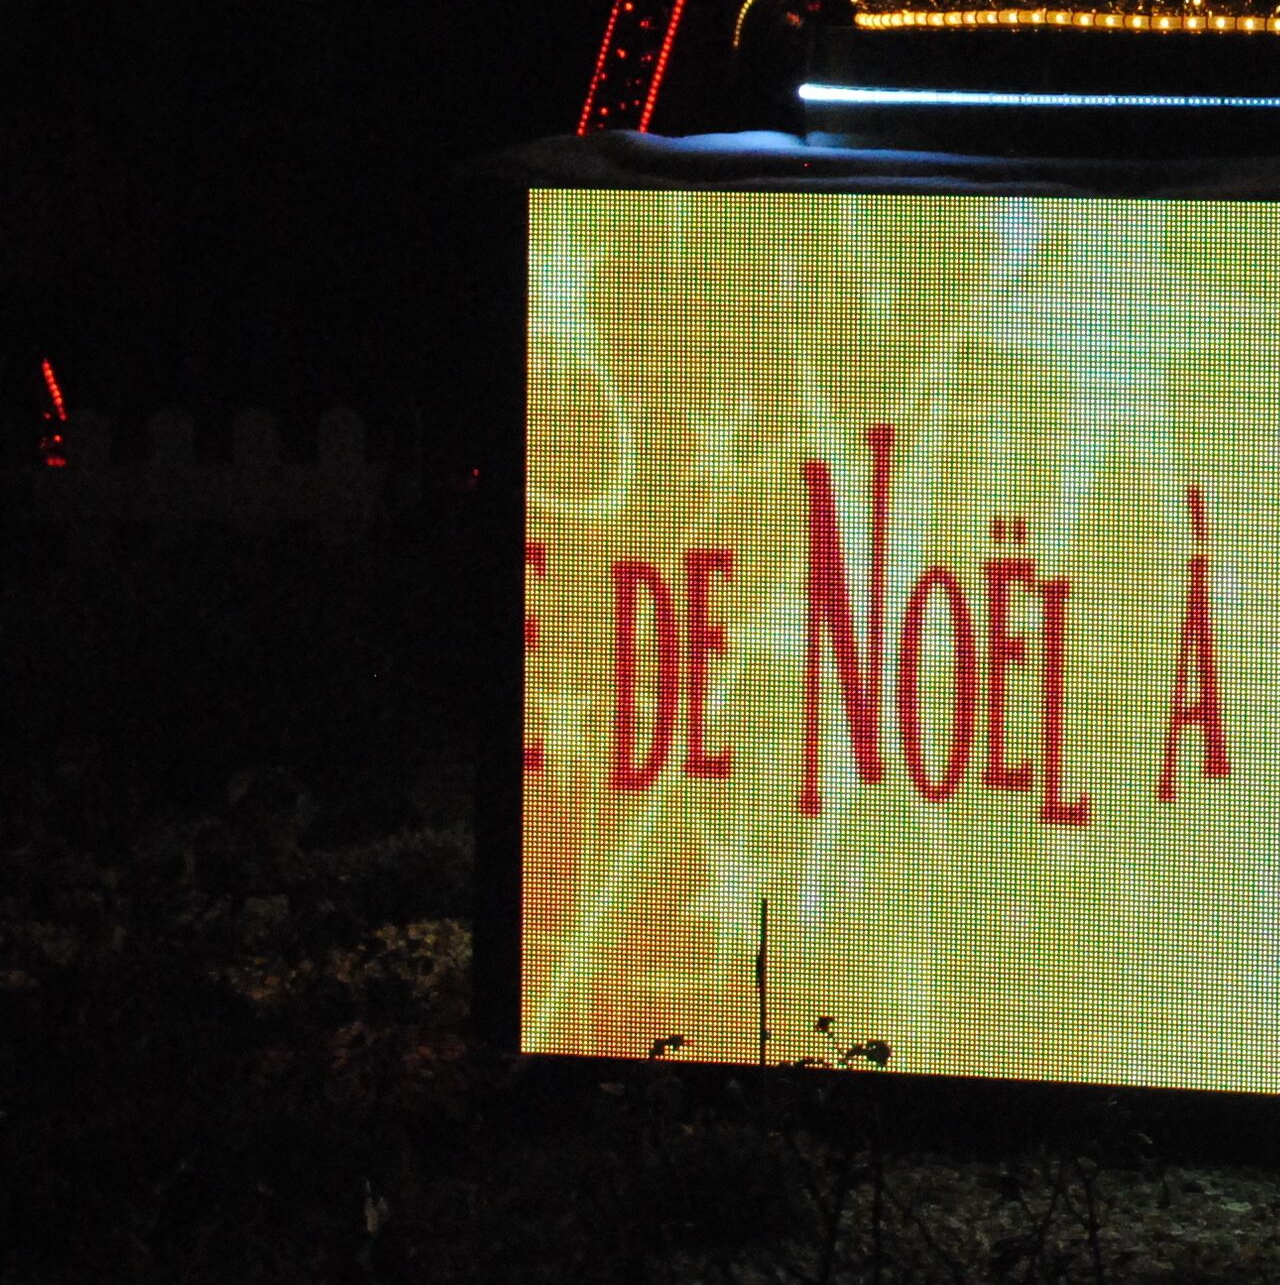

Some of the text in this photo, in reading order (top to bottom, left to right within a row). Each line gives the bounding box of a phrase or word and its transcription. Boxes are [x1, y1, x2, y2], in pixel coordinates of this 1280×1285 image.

[611, 549, 733, 792] DE
[800, 424, 1089, 826] NOËL
[1155, 484, 1230, 801] À
